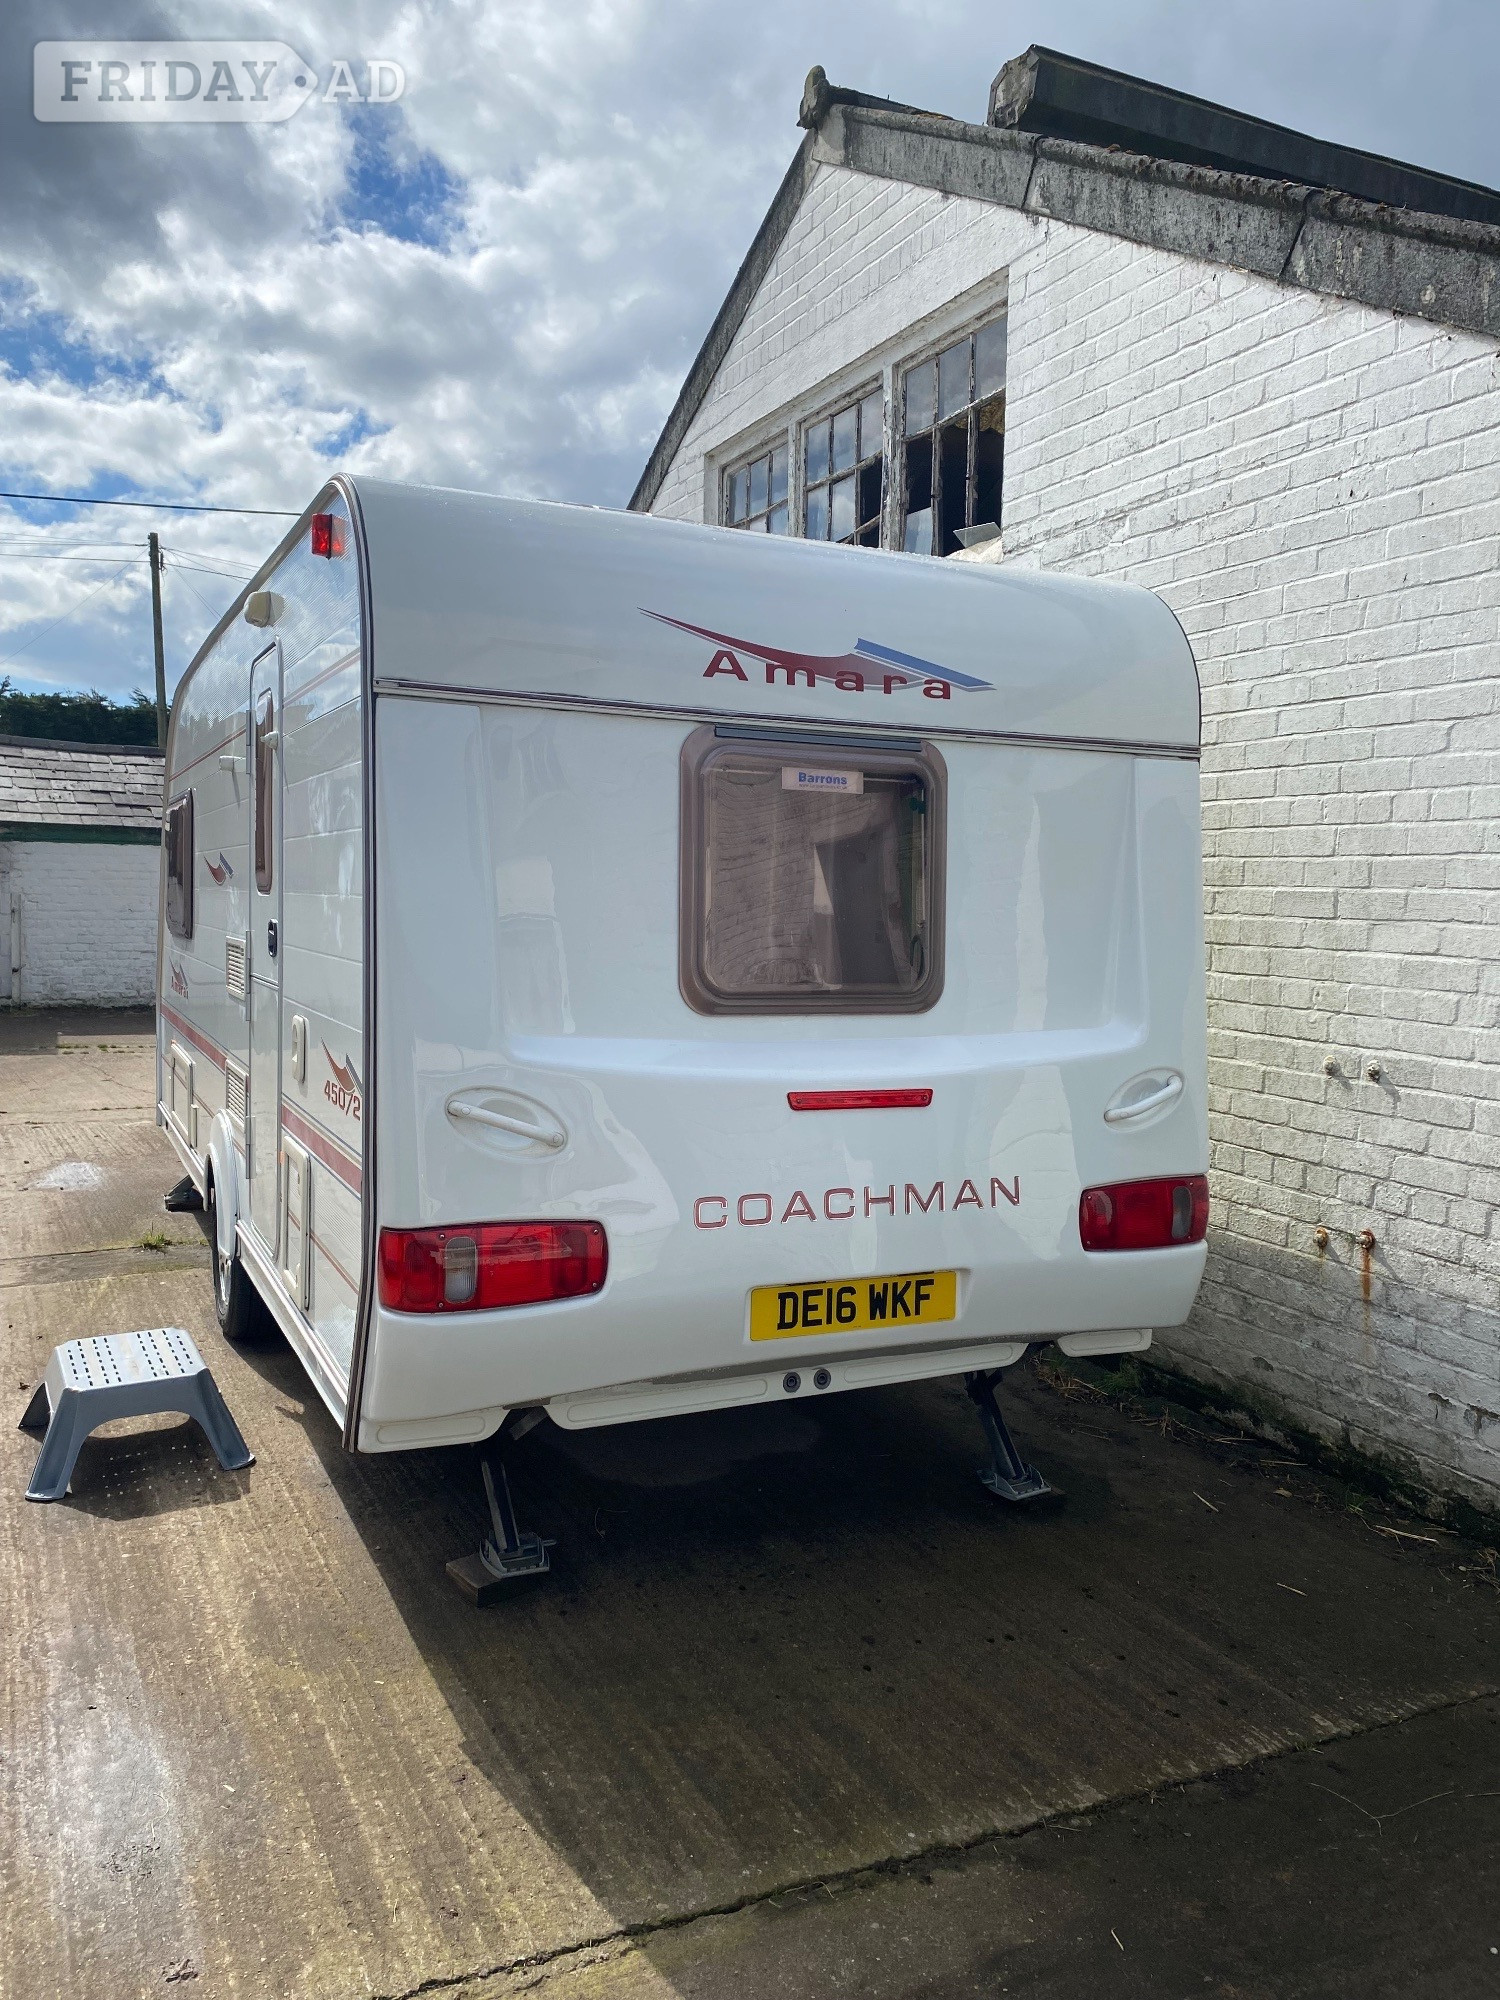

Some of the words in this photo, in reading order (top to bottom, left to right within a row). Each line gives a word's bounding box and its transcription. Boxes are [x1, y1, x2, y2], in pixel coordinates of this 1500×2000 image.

[703, 650, 951, 700] Amara
[798, 772, 848, 785] Barrons
[324, 1080, 361, 1121] 450/2
[693, 1175, 1021, 1230] COACHMAN
[777, 1287, 857, 1331] DE16
[868, 1278, 935, 1321] WKF
